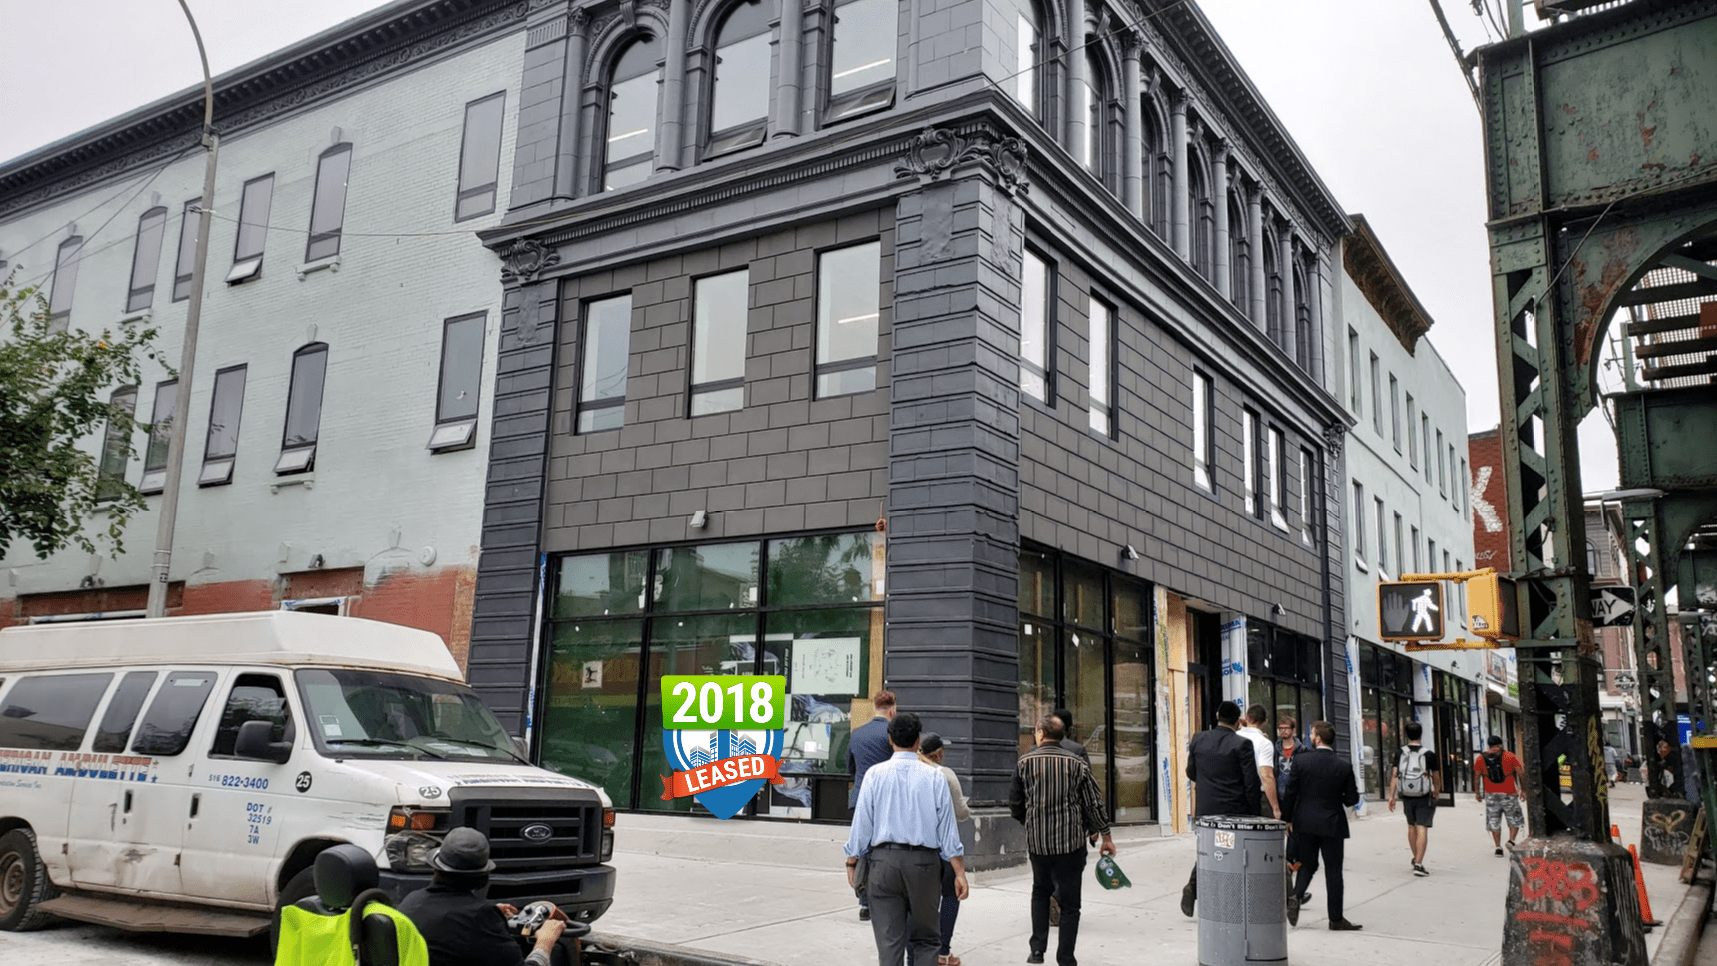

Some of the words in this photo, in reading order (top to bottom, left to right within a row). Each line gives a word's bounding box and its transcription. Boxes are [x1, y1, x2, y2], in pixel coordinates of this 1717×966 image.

[0, 750, 52, 775] ERICAN
[208, 774, 221, 782] 516
[221, 775, 269, 789] 822-3400
[296, 774, 311, 788] 25
[421, 786, 440, 798] 25
[246, 802, 265, 813] DOT
[247, 813, 272, 825] 32519
[249, 825, 260, 835] 7A
[247, 835, 260, 845] 3W
